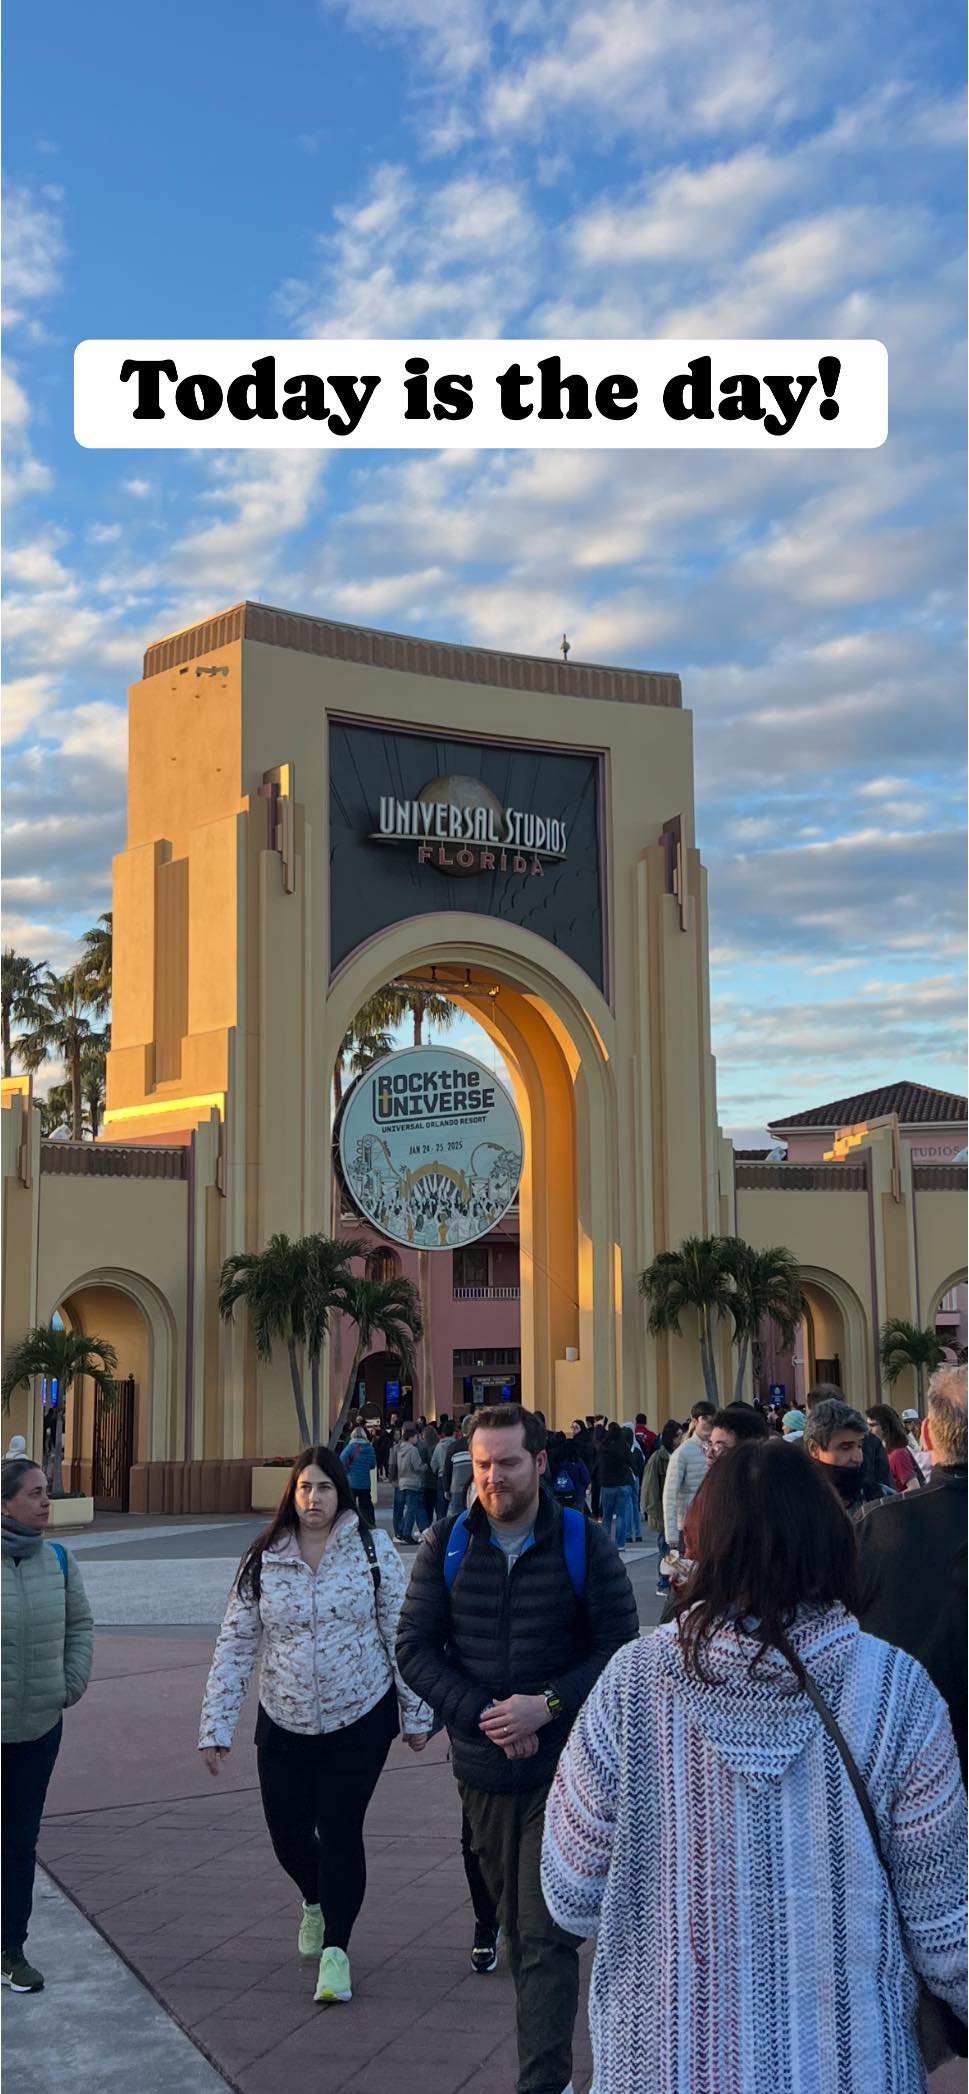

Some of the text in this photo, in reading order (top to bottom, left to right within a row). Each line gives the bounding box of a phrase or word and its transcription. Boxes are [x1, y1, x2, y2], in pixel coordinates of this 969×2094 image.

[379, 796, 568, 853] UNIVERSAL STUDIOS
[417, 846, 544, 877] FLORIDA
[378, 1088, 495, 1118] UNIVERSE
[381, 1115, 486, 1133] UNIVERSAL ORLANDO RESORT
[409, 1145, 421, 1155] JAN
[447, 1141, 463, 1151] 2025
[911, 1145, 960, 1157] TUDIOS
